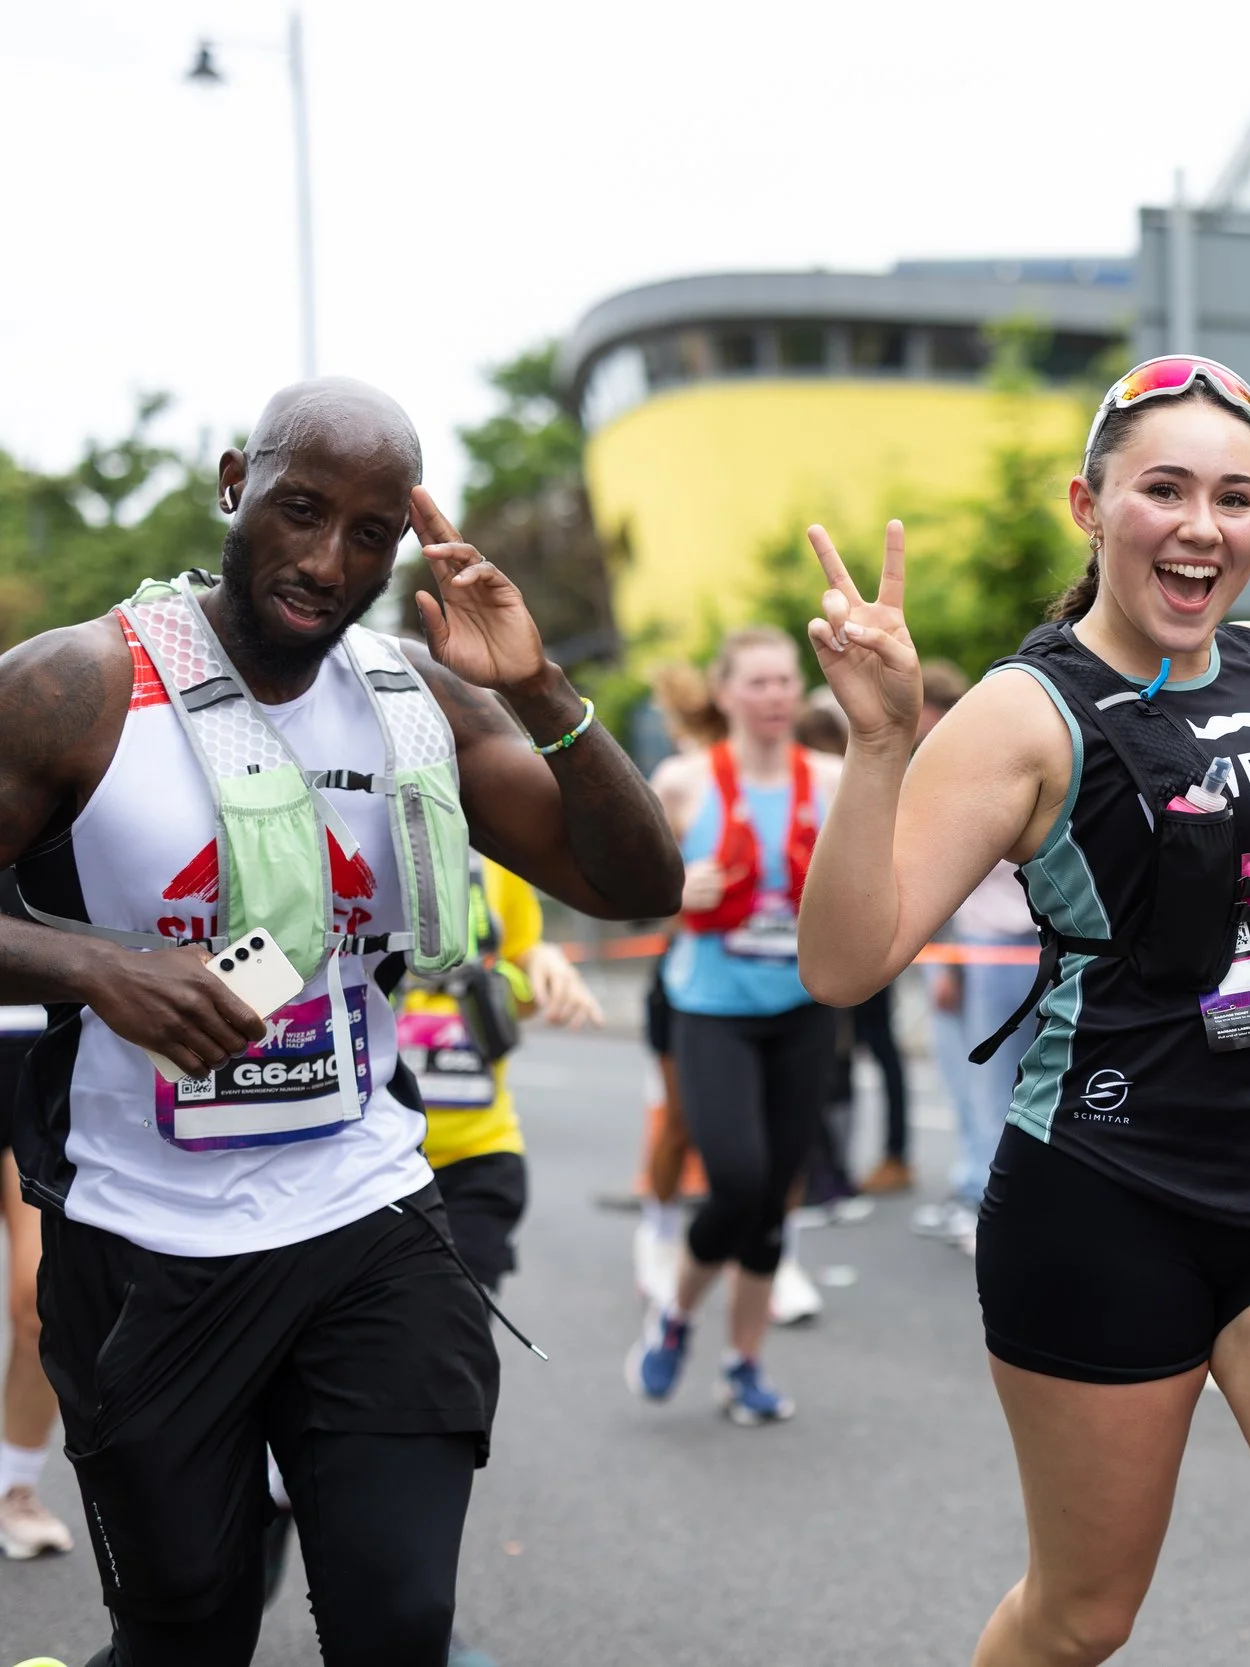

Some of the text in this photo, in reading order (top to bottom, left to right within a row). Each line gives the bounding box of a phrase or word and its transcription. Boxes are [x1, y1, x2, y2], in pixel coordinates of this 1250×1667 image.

[325, 1009, 362, 1033] 225
[286, 1034, 317, 1043] HACKNEY
[1073, 1111, 1130, 1124] SCIMITAR
